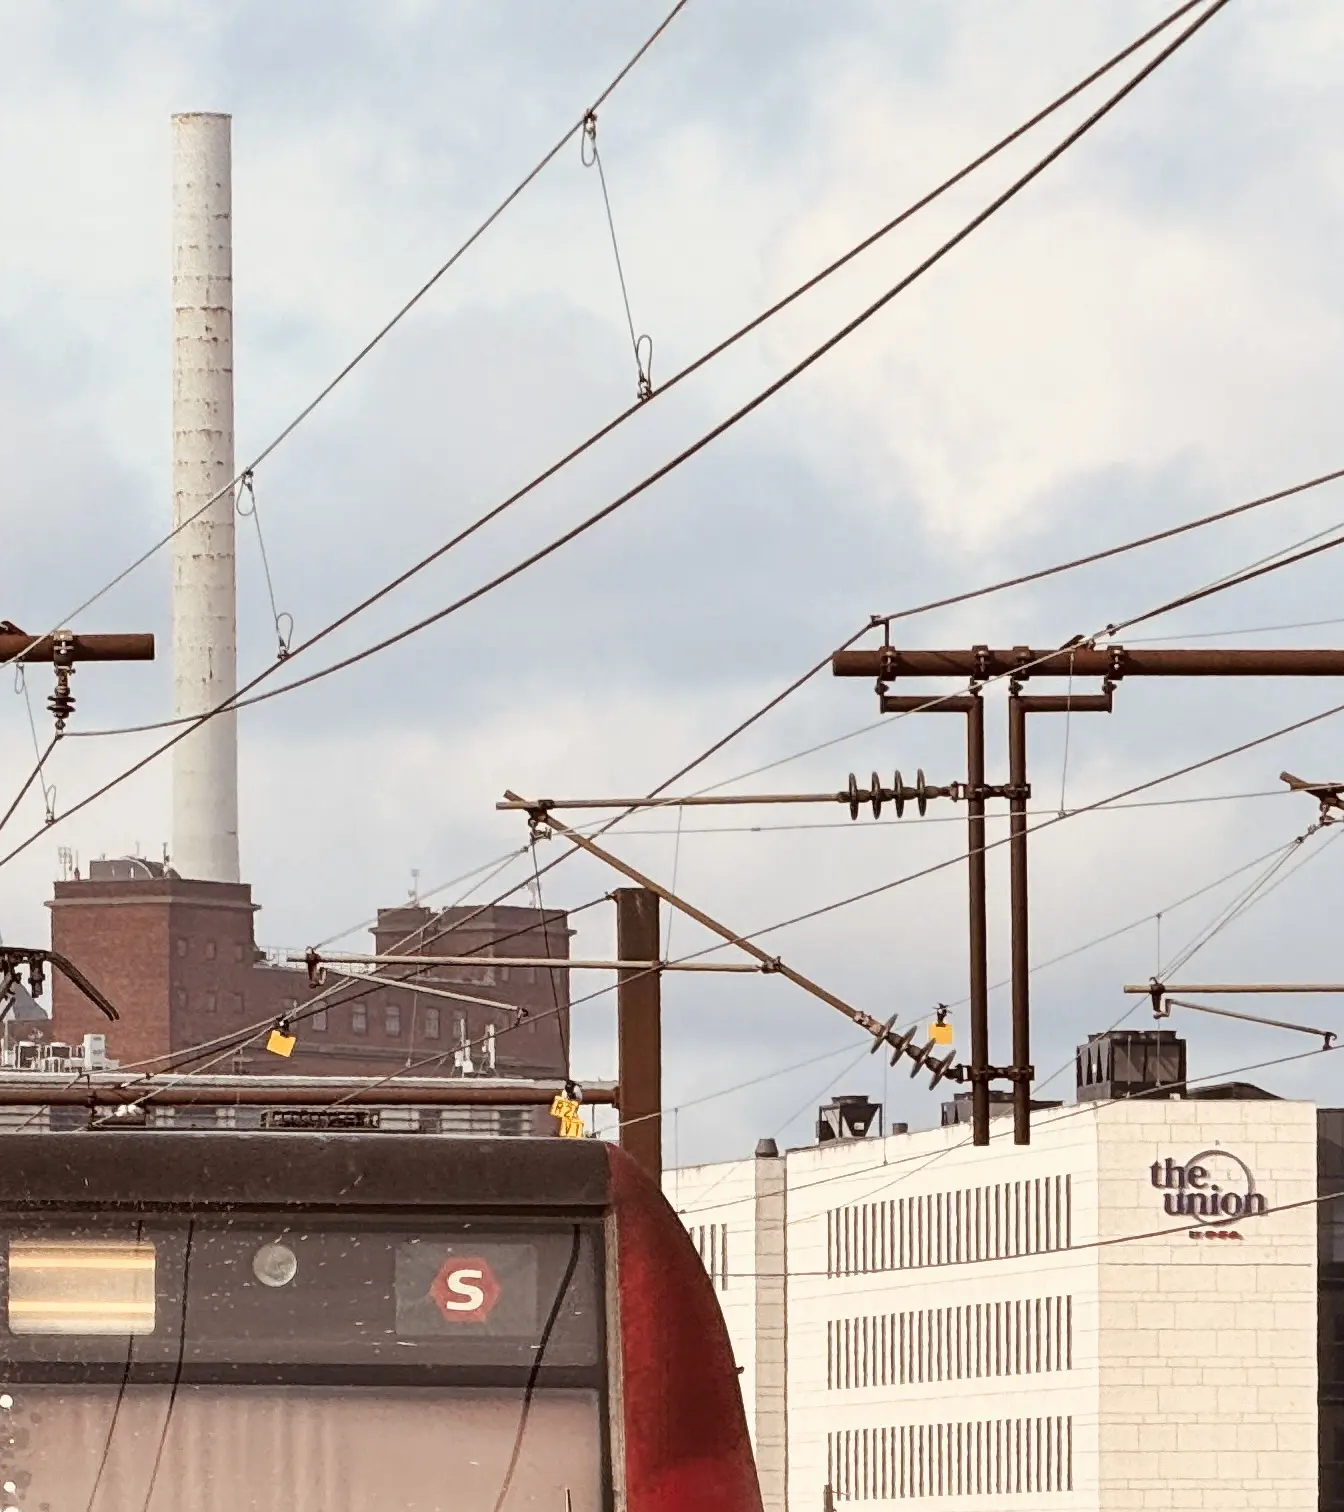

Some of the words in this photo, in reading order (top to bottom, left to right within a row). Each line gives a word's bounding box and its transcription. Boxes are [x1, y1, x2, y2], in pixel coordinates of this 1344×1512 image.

[1150, 1157, 1209, 1189] the
[1163, 1184, 1267, 1217] union
[446, 1268, 484, 1311] S
